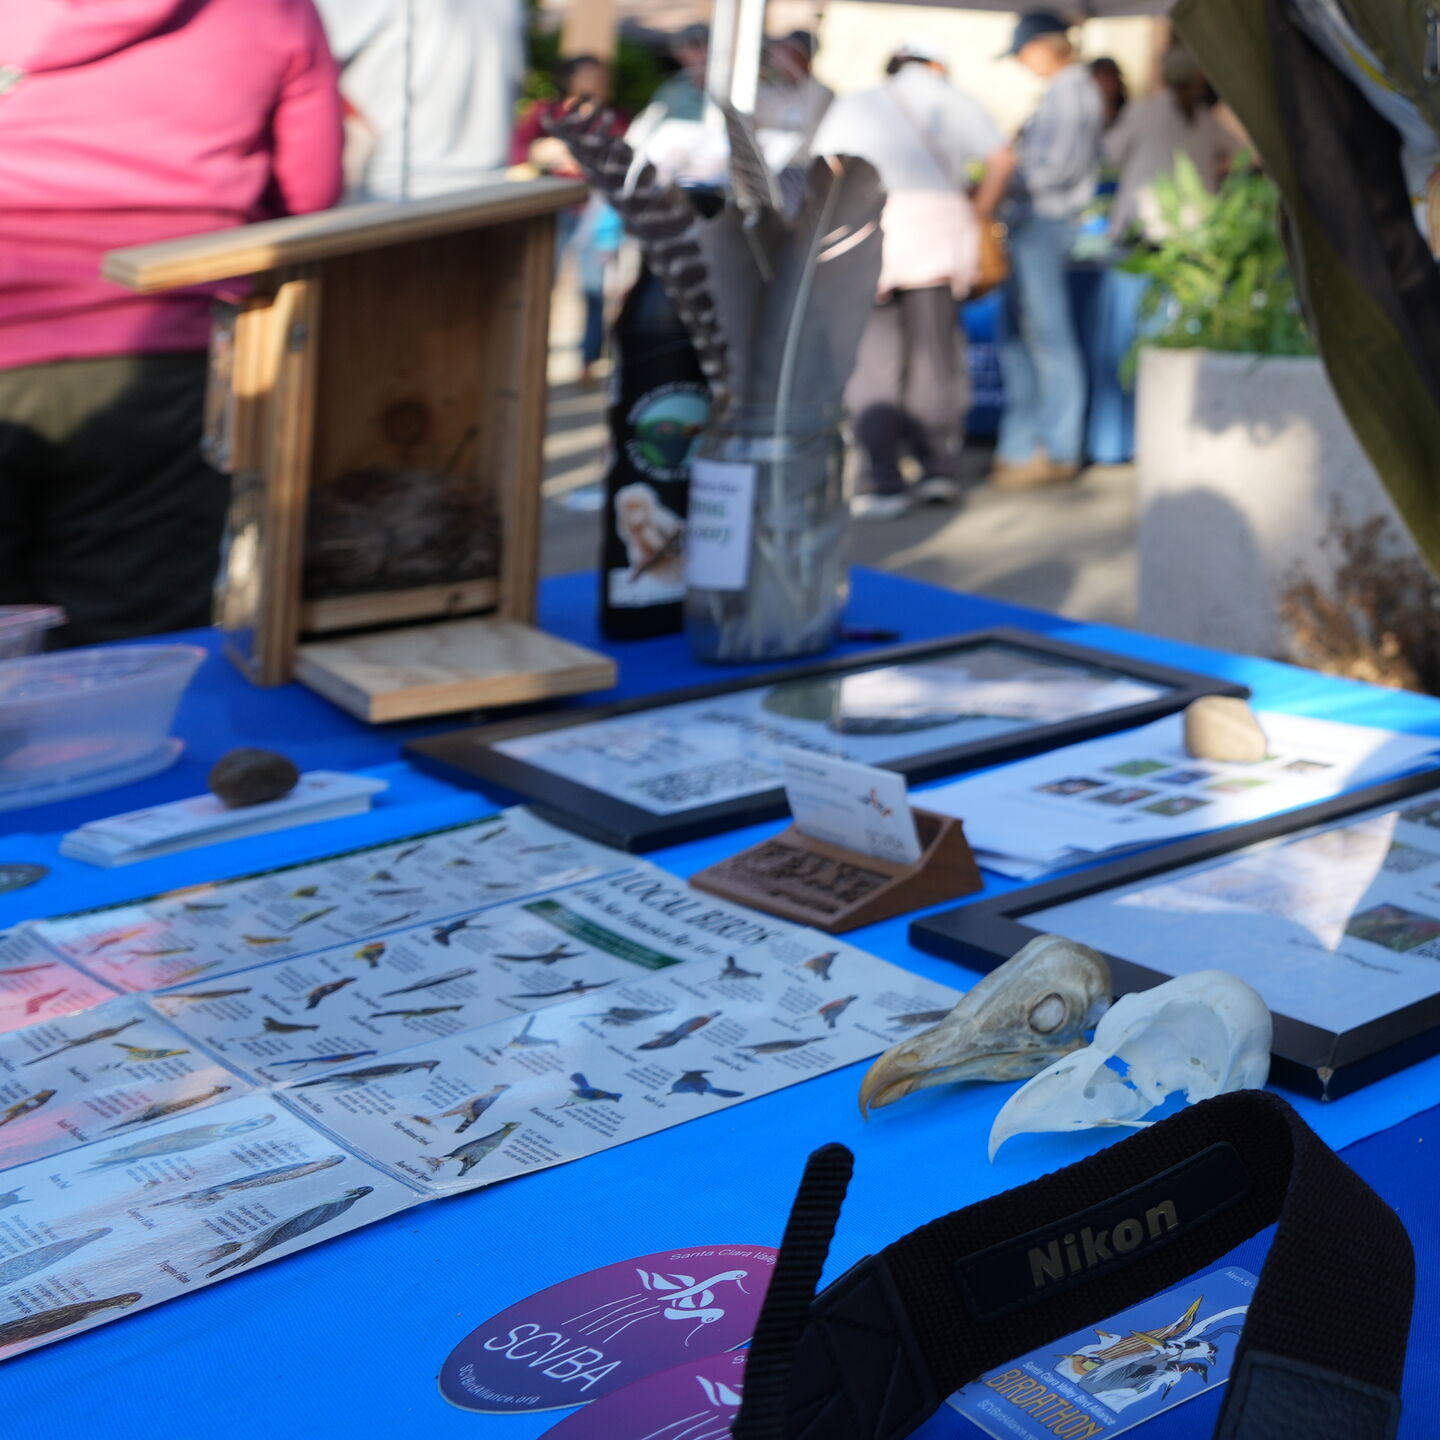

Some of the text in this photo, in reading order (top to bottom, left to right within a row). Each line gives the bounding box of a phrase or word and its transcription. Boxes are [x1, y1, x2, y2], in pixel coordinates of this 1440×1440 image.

[607, 871, 703, 917] LOCAL
[684, 910, 772, 947] BIRDS
[670, 1250, 715, 1261] Santa
[718, 1248, 752, 1257] Clara
[1027, 1199, 1178, 1288] Nikon
[483, 1323, 622, 1392] SCVBA
[1022, 1361, 1043, 1375] Santa
[1040, 1371, 1060, 1386] Clara
[1057, 1382, 1078, 1398] Valley
[1073, 1394, 1094, 1408] Bird
[984, 1368, 1105, 1440] BIRDATHON
